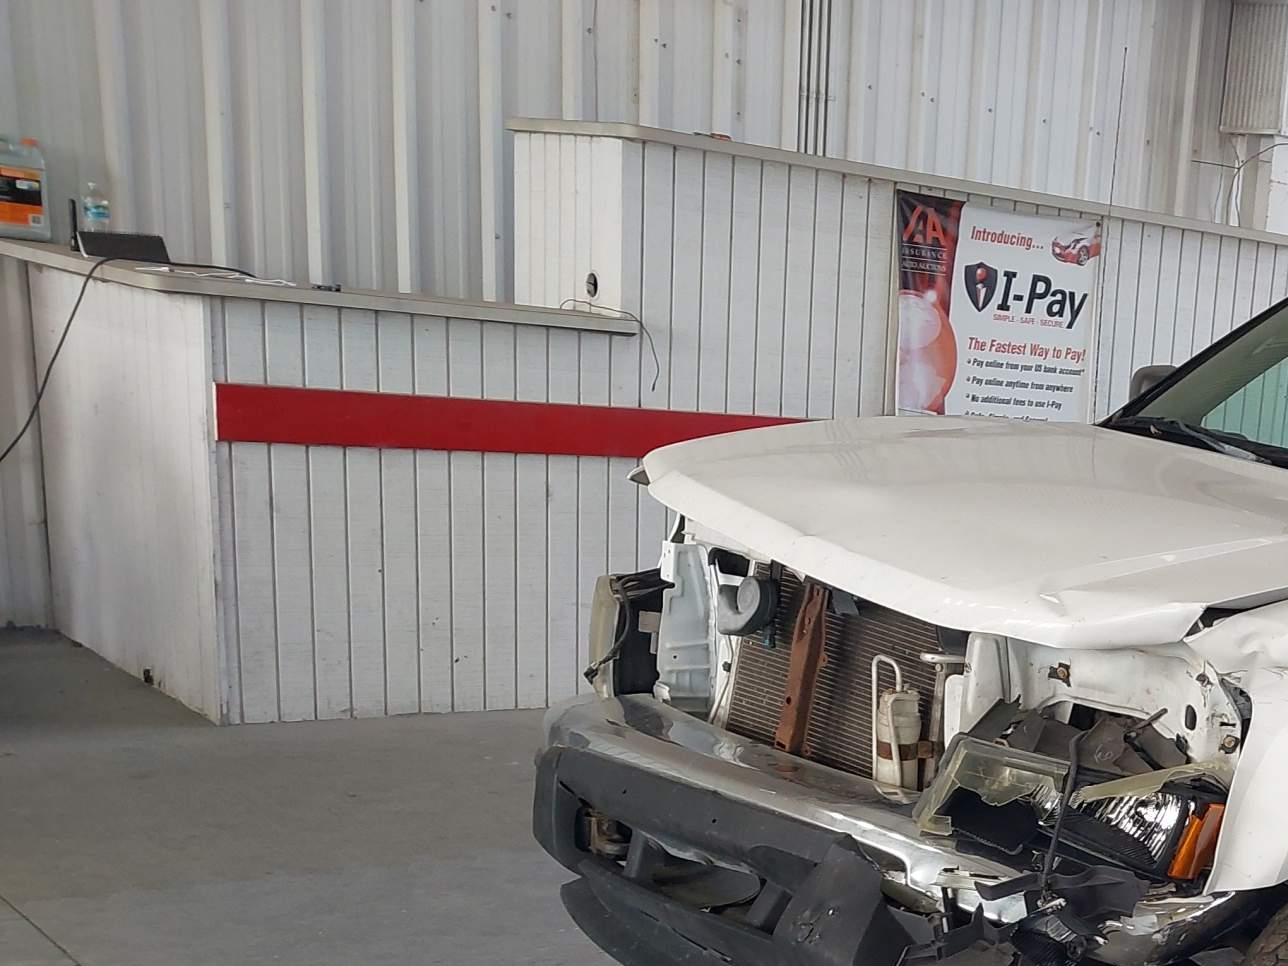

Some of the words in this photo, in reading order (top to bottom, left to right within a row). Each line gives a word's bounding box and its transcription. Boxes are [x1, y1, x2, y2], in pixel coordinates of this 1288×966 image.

[970, 226, 1044, 250] Introducing...
[996, 270, 1088, 329] I-Pay
[993, 313, 1015, 322] SIMPLE
[1020, 316, 1035, 324] SAFE
[1040, 319, 1064, 328] SECURE
[968, 337, 986, 351] The
[988, 339, 1026, 355] Fastest
[1029, 343, 1050, 360] Way
[1052, 346, 1061, 359] to
[1064, 347, 1086, 363] Pay!
[972, 358, 983, 368] Pay
[985, 360, 1004, 368] online
[1005, 361, 1019, 369] from
[1019, 363, 1033, 372] your
[971, 376, 983, 386] Pay
[984, 378, 1003, 386] online
[1005, 379, 1029, 389] anytime
[1030, 381, 1044, 390] from
[1045, 383, 1073, 392] anywhere
[980, 396, 1011, 404] additional
[1012, 398, 1025, 406] fees
[1027, 399, 1033, 407] to
[1034, 400, 1045, 408] use
